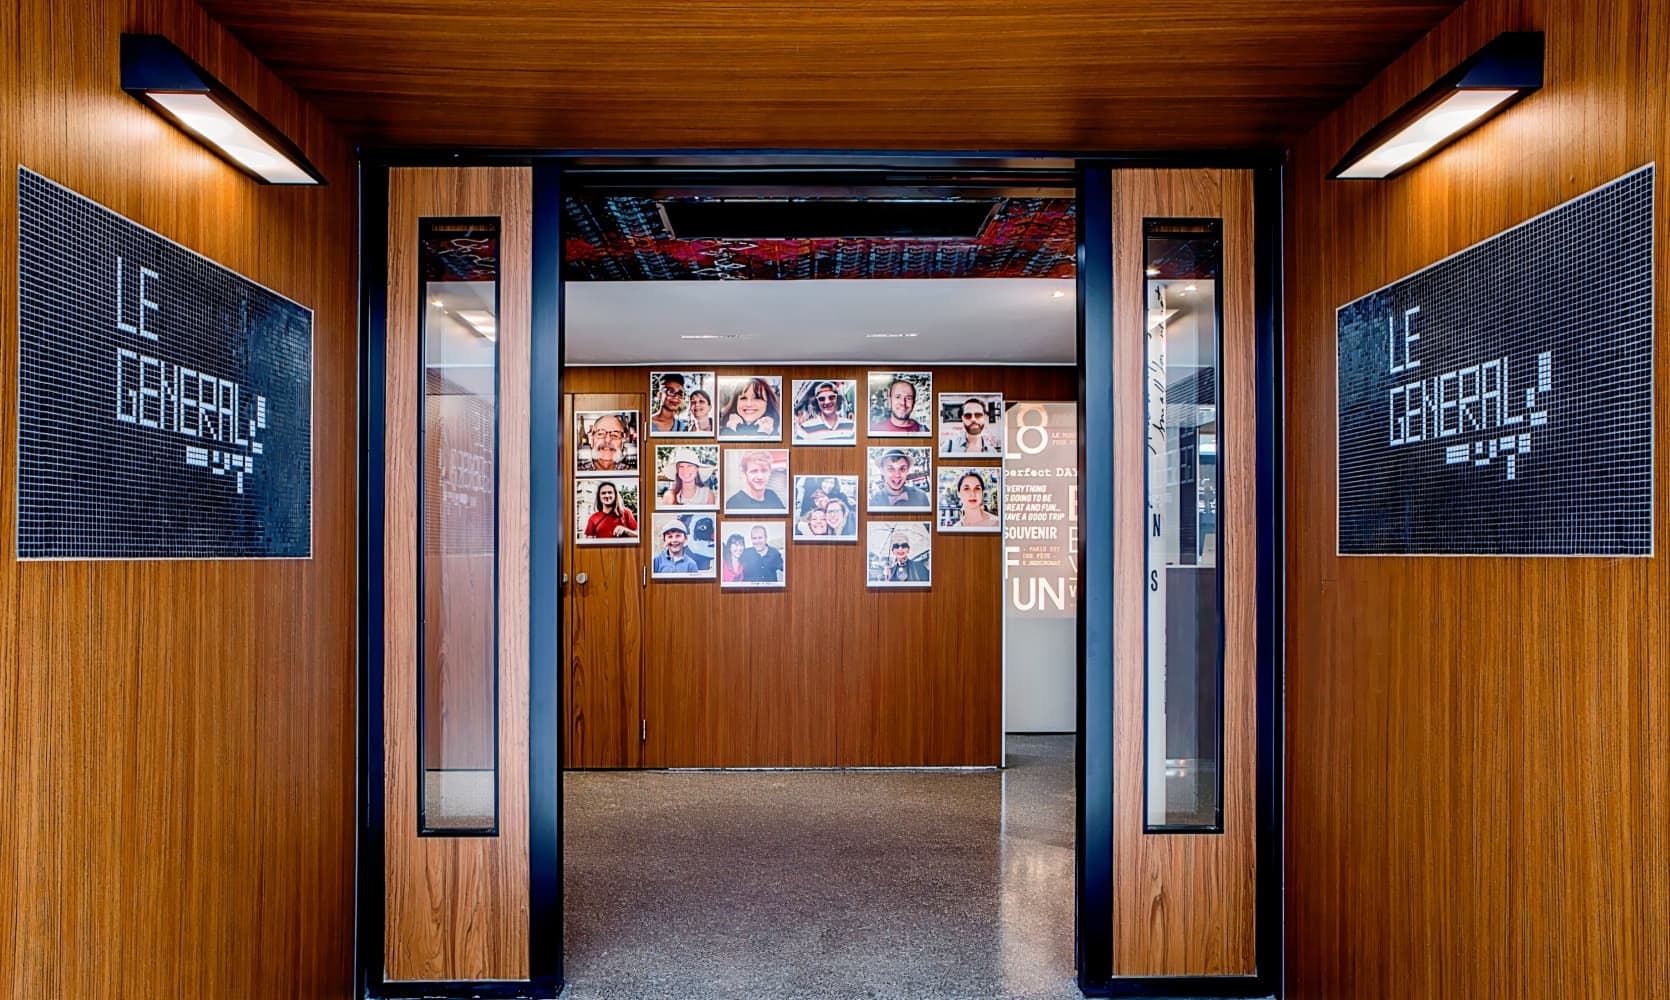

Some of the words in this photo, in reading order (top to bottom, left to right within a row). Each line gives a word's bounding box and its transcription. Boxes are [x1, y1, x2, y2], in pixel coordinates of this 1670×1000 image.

[117, 256, 159, 341] LE
[1390, 306, 1420, 374] LE
[117, 347, 249, 446] GENERAL
[1390, 356, 1523, 446] GENERAL
[1006, 484, 1047, 493] VERYTHING
[1006, 503, 1025, 511] REAT
[1025, 503, 1041, 511] AND
[1032, 494, 1042, 502] TO
[1021, 512, 1027, 520] A
[1028, 512, 1048, 521] GOOD
[1048, 512, 1065, 521] TRIP
[1005, 526, 1057, 540] SOUVENIR
[1150, 570, 1159, 592] S
